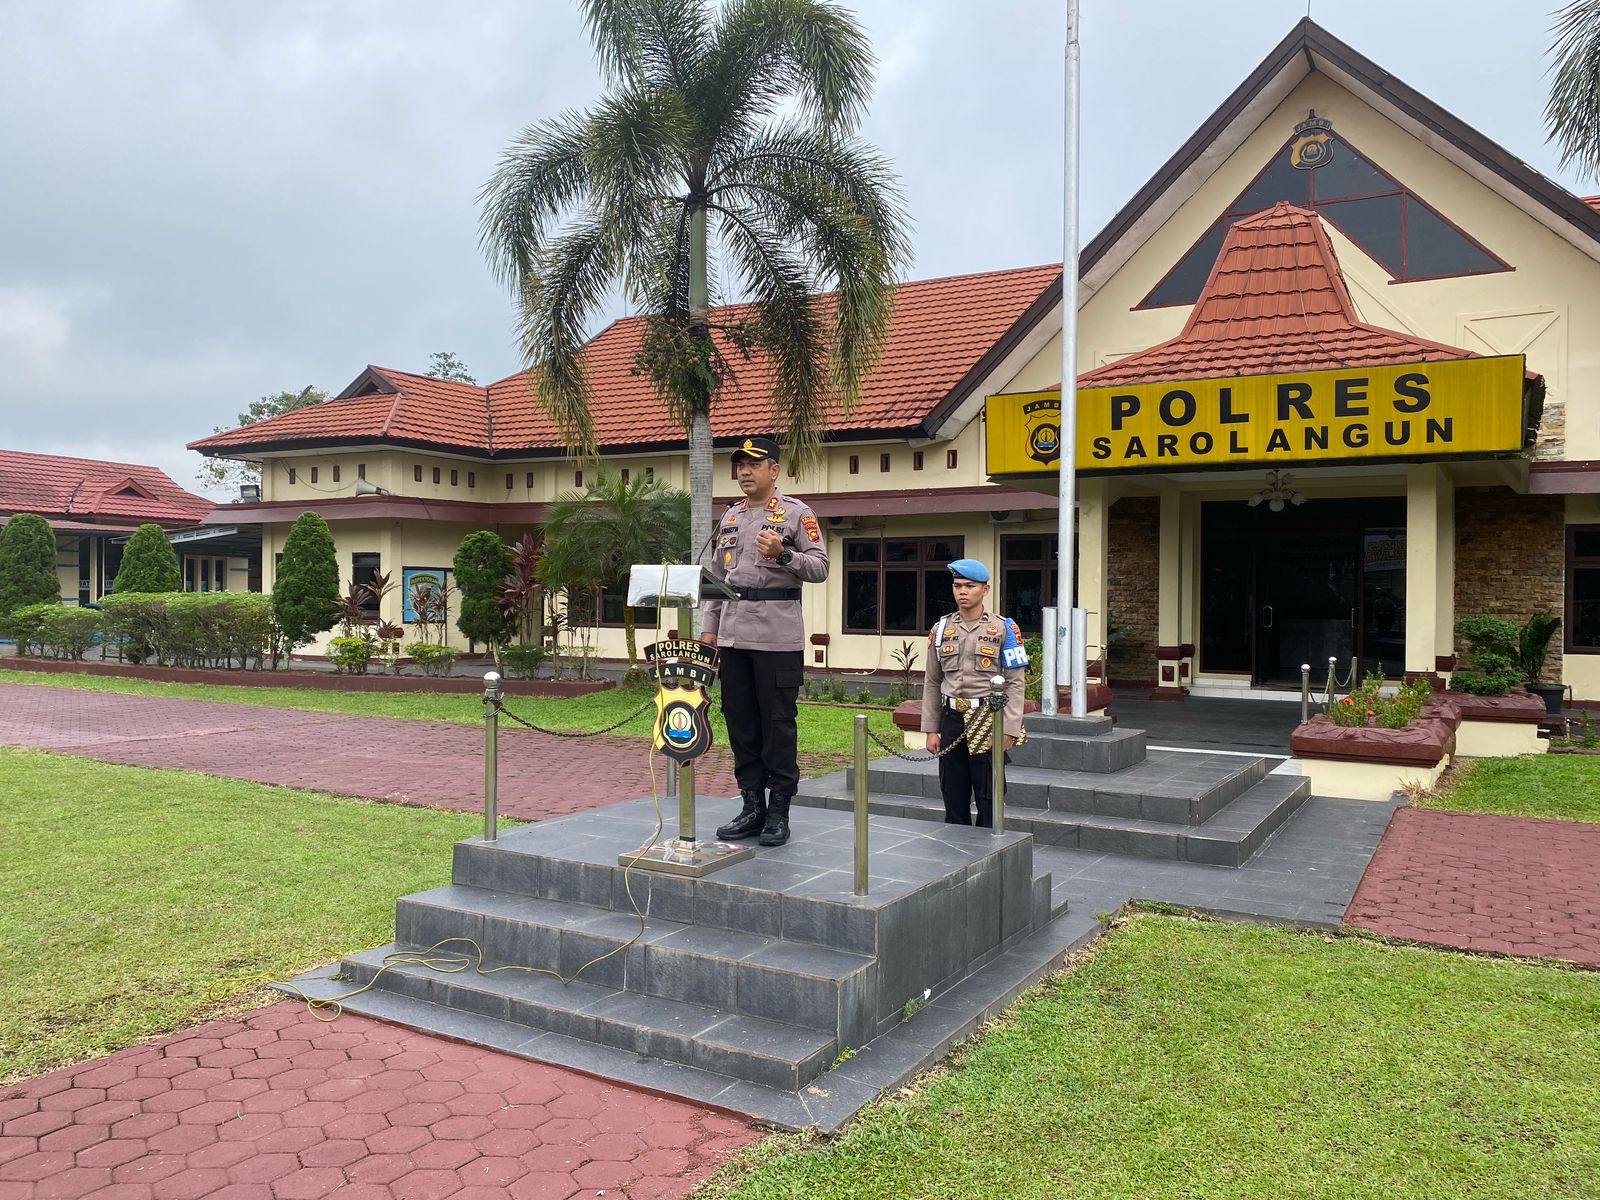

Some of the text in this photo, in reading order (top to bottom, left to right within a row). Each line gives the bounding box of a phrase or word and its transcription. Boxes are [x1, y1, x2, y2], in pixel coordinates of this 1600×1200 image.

[1026, 402, 1059, 412] JAMB
[1111, 373, 1431, 431] POLRES
[1092, 418, 1453, 459] SAROLANGUN
[761, 524, 785, 534] POLRI
[978, 635, 1000, 644] POLRI
[658, 640, 700, 653] POLRES
[649, 650, 711, 664] SAROLANGUN
[653, 667, 706, 682] JAMBI
